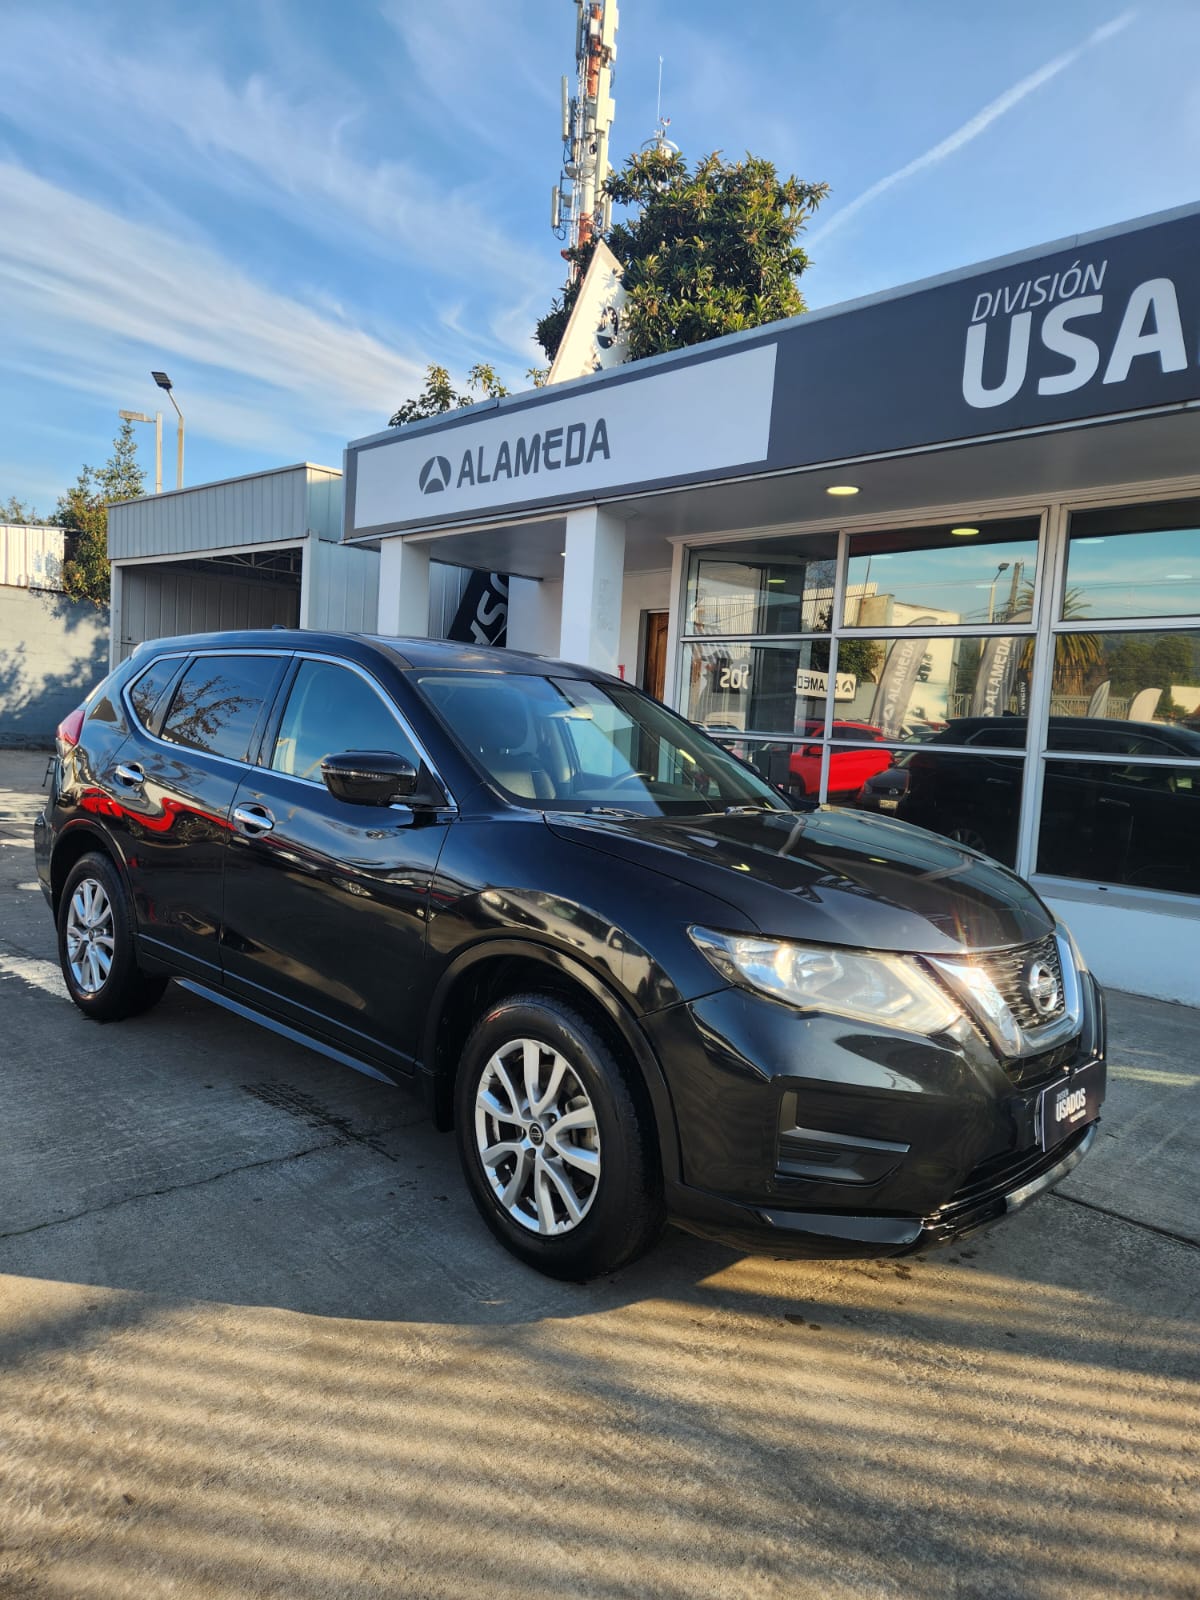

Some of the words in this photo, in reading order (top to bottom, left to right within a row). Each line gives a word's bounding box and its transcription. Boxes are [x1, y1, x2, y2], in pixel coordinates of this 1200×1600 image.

[971, 259, 1108, 322] DIVISIÓN
[456, 417, 611, 489] ALAMEDA
[888, 640, 917, 704] ALAMEDA
[986, 637, 1012, 705] ALAMEDA
[1055, 1087, 1087, 1123] USADOS
